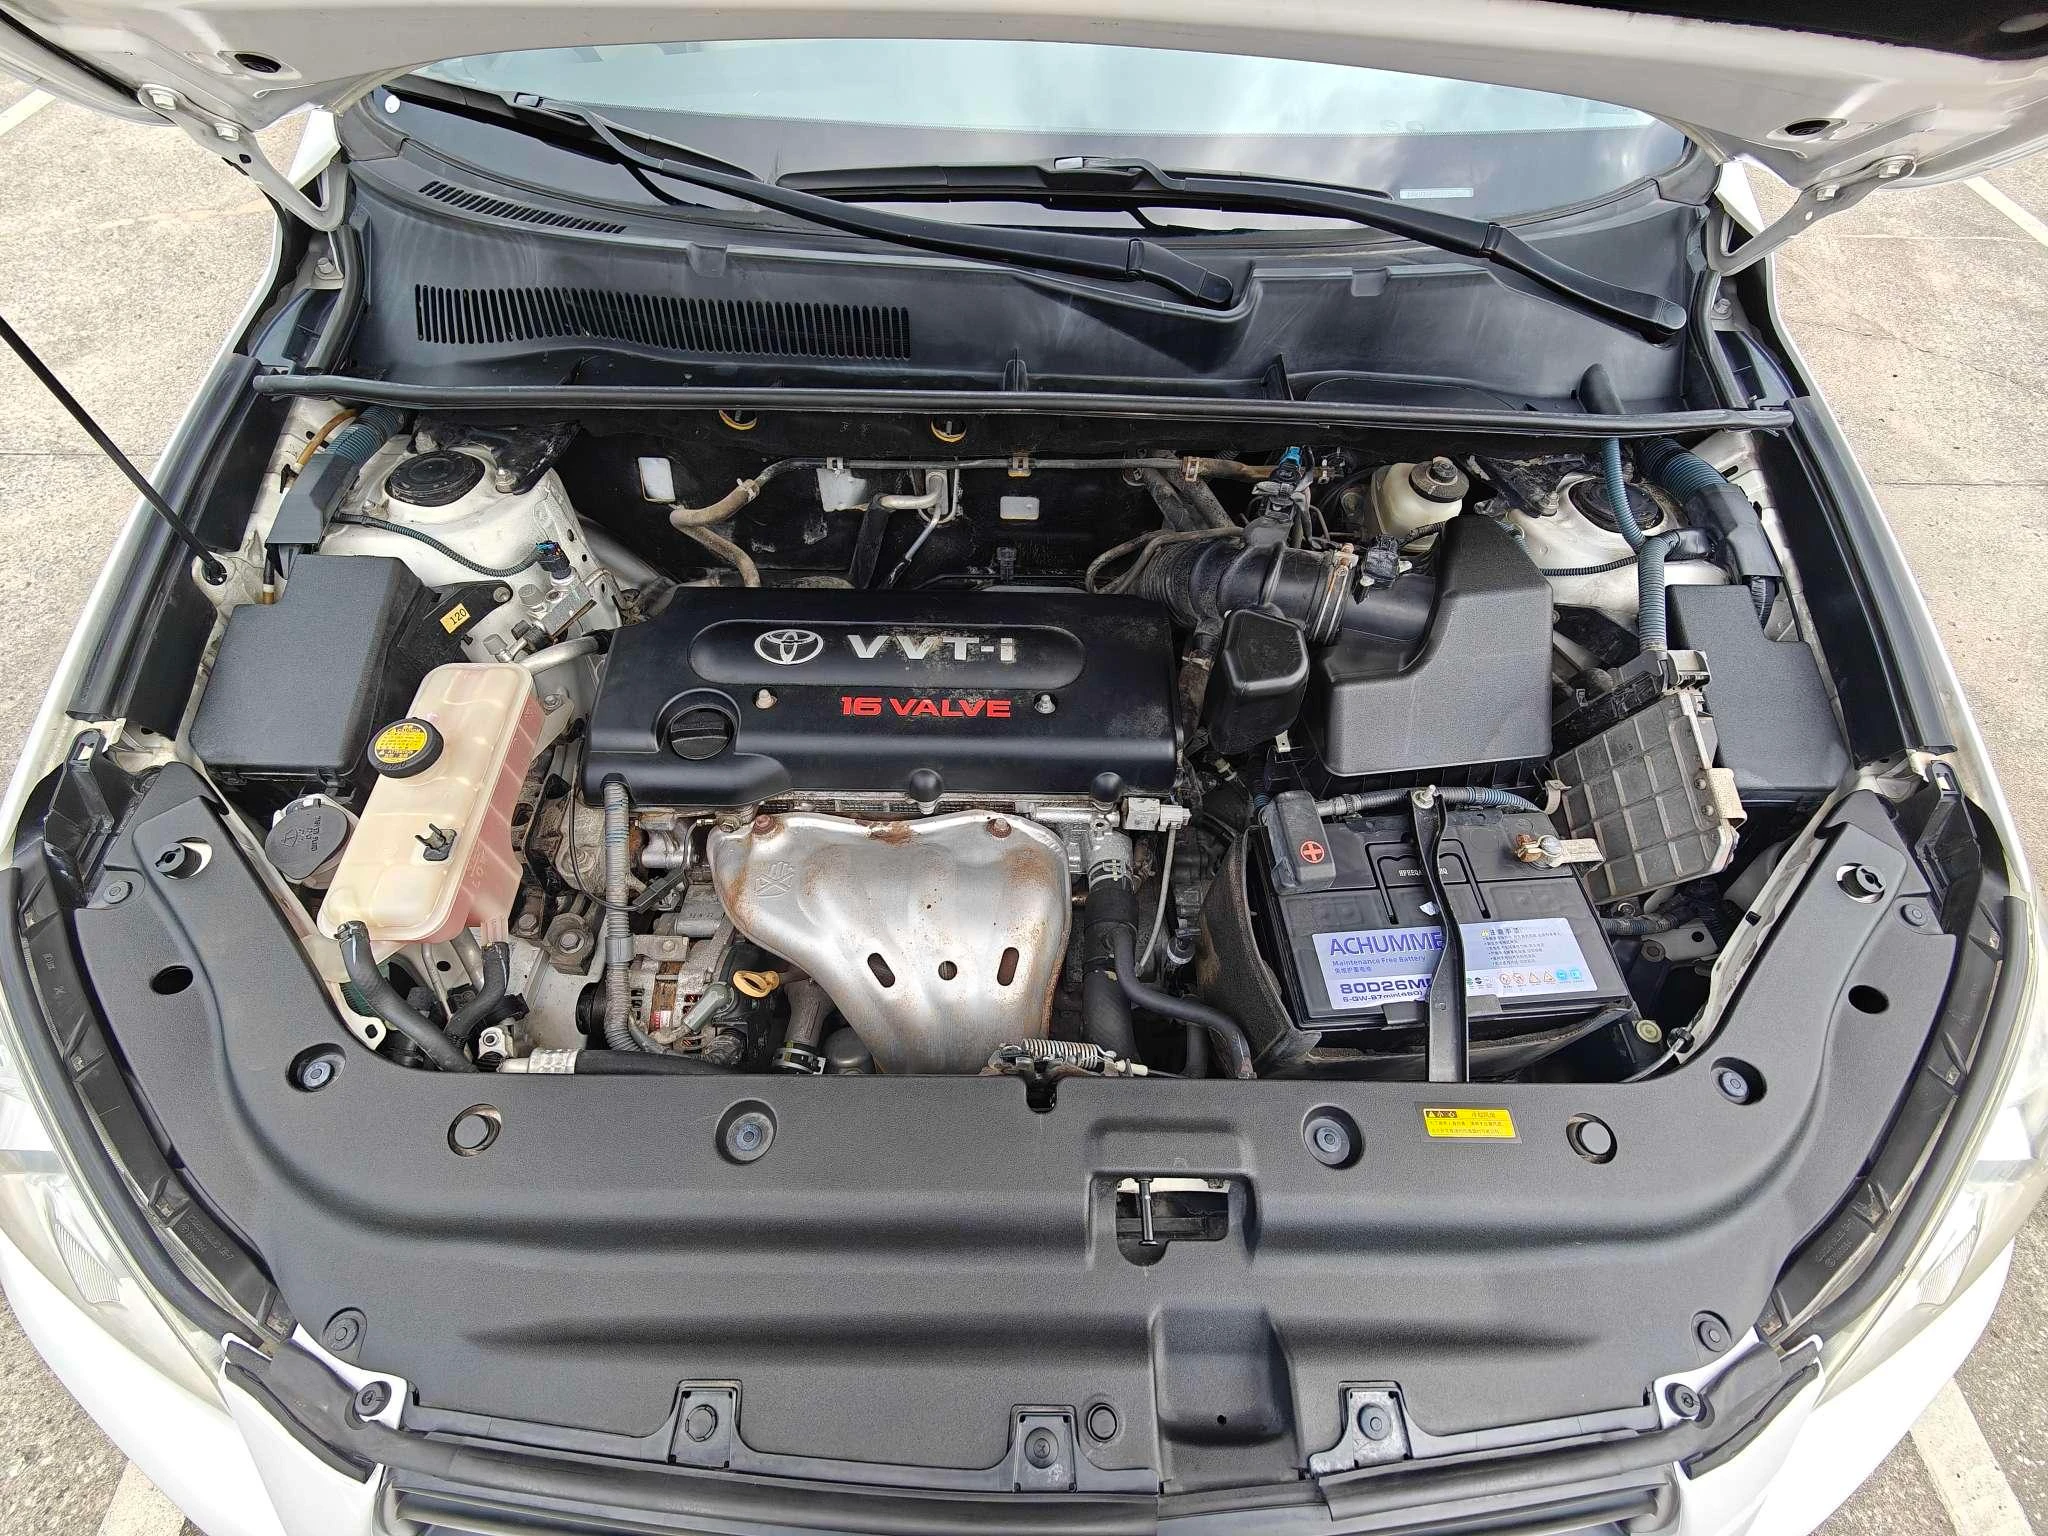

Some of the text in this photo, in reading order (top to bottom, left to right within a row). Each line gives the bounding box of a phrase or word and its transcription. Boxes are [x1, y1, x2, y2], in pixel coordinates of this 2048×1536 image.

[449, 607, 468, 626] 120
[848, 634, 1014, 662] VVT-i
[840, 696, 1012, 718] 16 VALVE
[1332, 954, 1426, 967] Maintenance Free Battery
